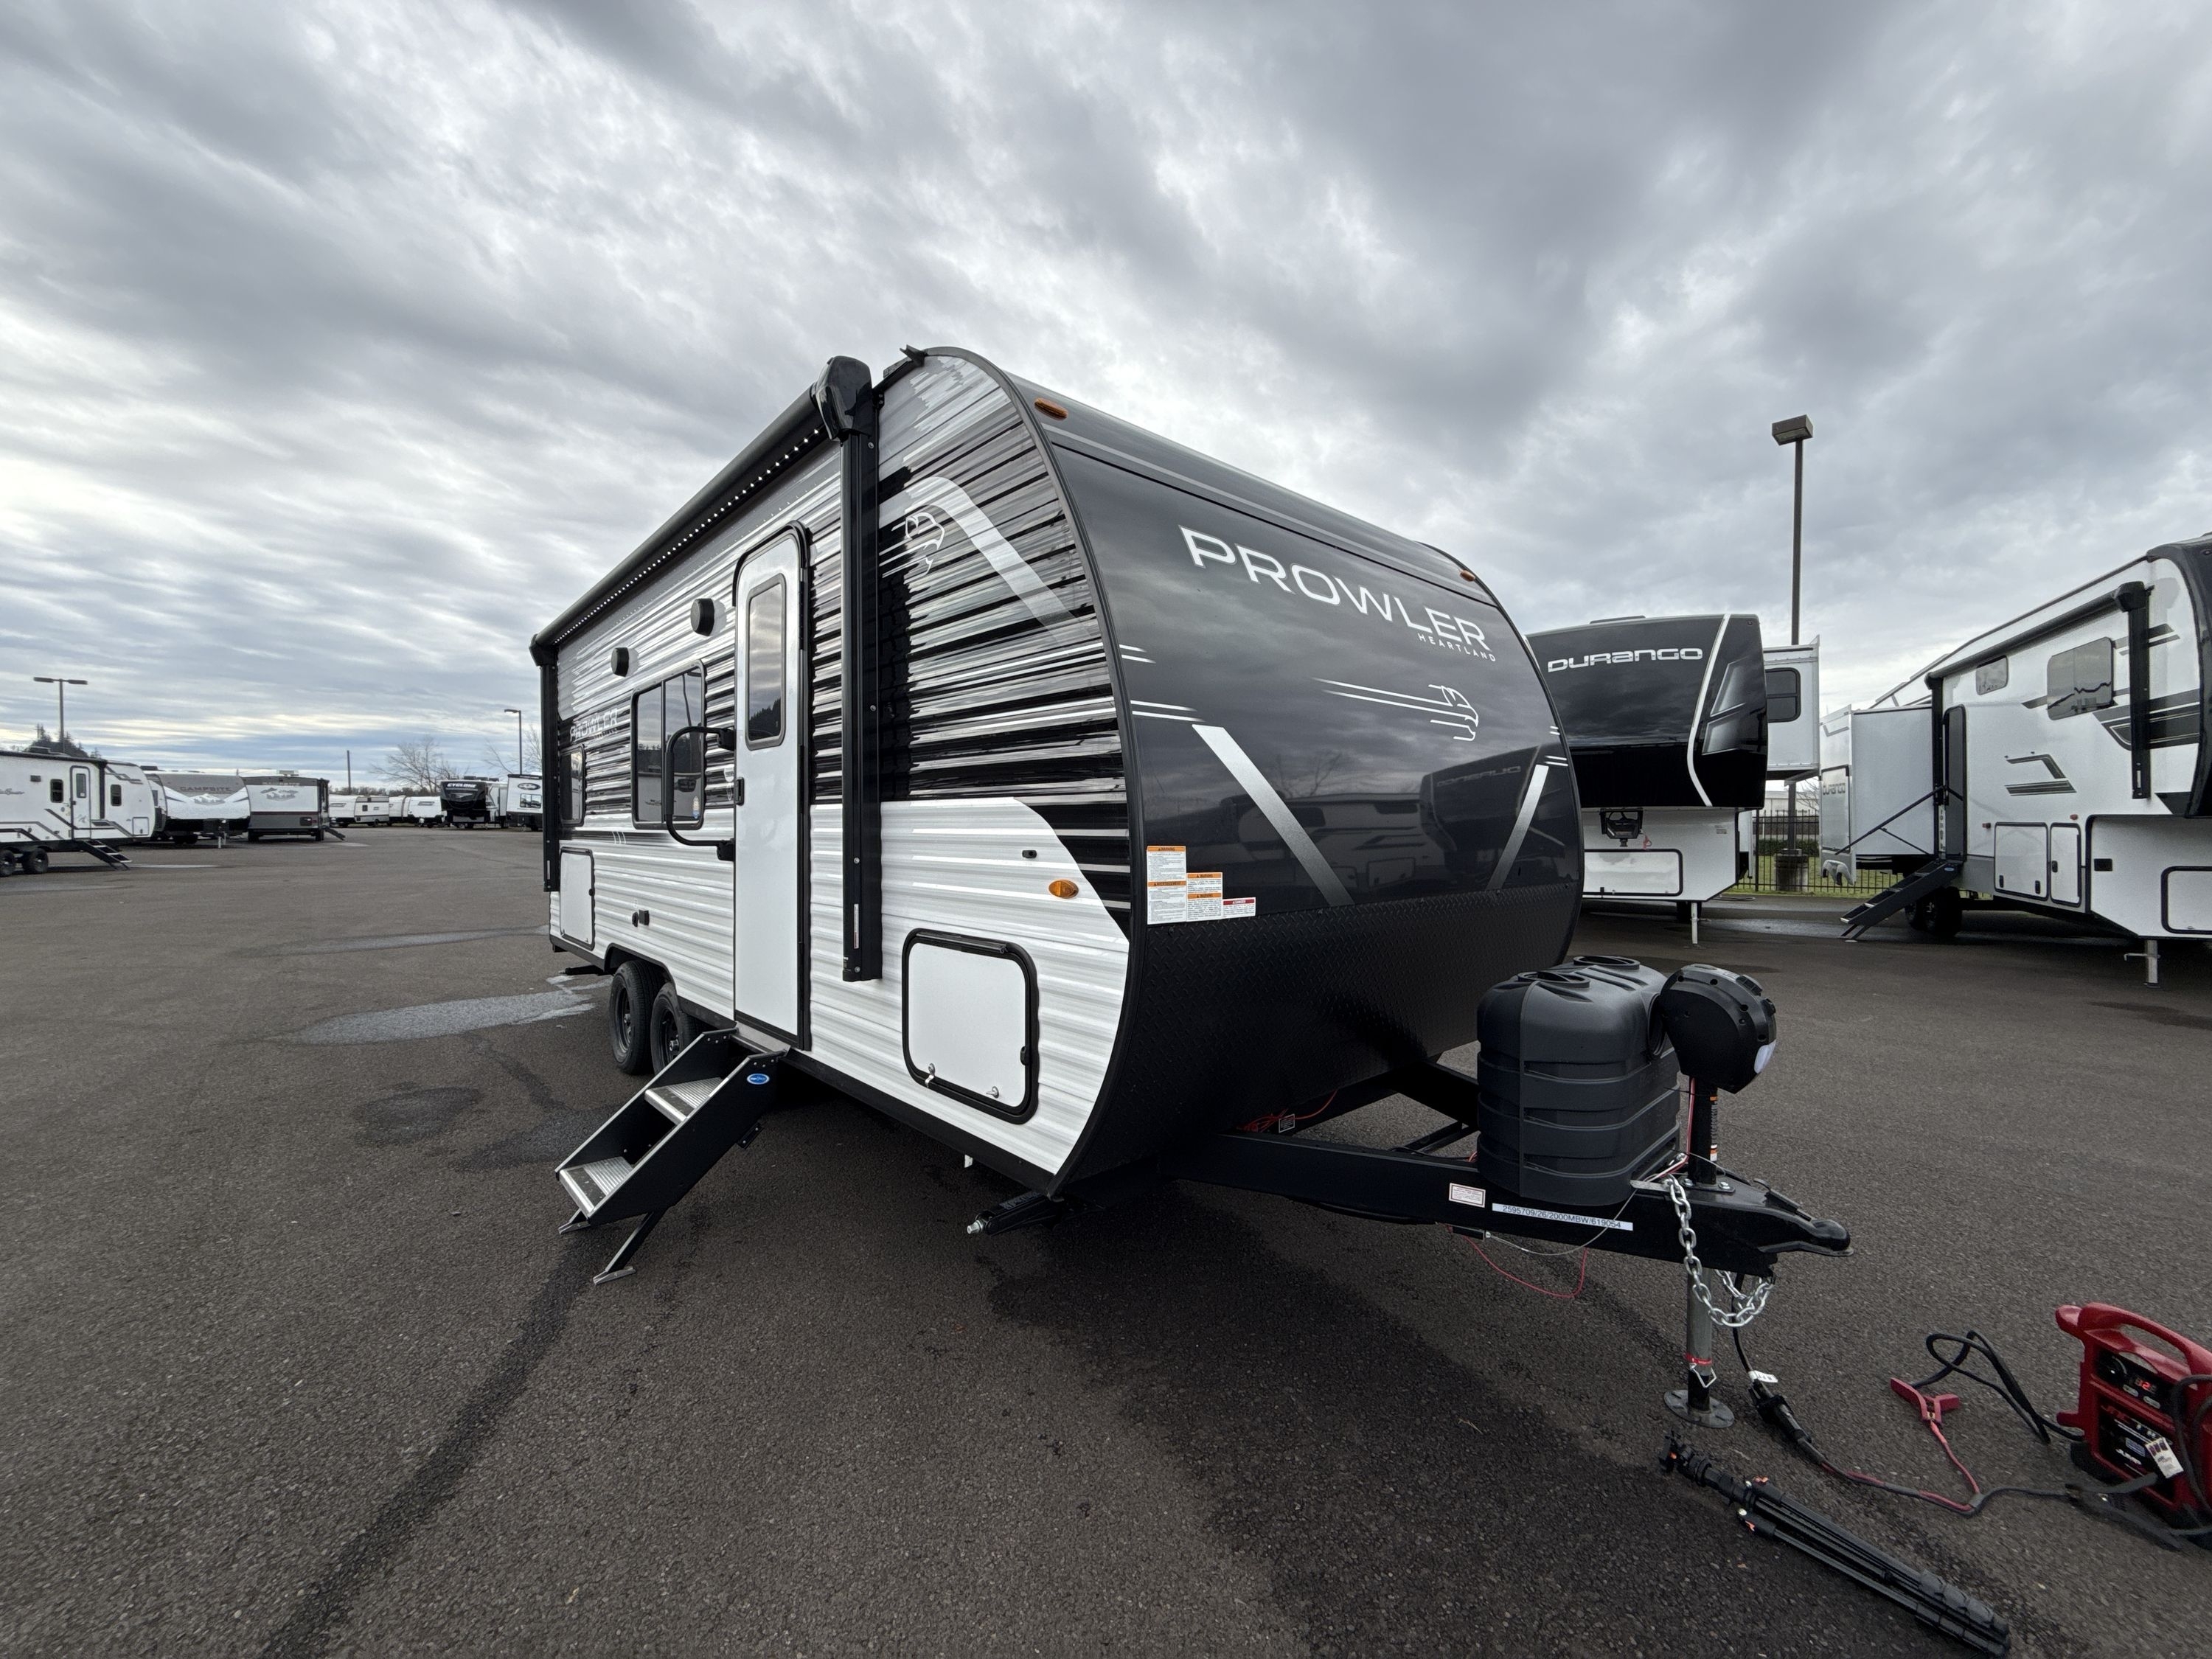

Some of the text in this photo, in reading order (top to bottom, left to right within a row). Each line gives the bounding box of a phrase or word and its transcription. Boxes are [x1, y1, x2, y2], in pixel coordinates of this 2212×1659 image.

[1179, 525, 1492, 652] PROWLER
[1417, 633, 1496, 662] HEARTLAND
[1548, 648, 1703, 672] DURANGO
[570, 708, 618, 743] PROWLER
[1503, 1205, 1621, 1228] 2595709/26/2000MBW/619054
